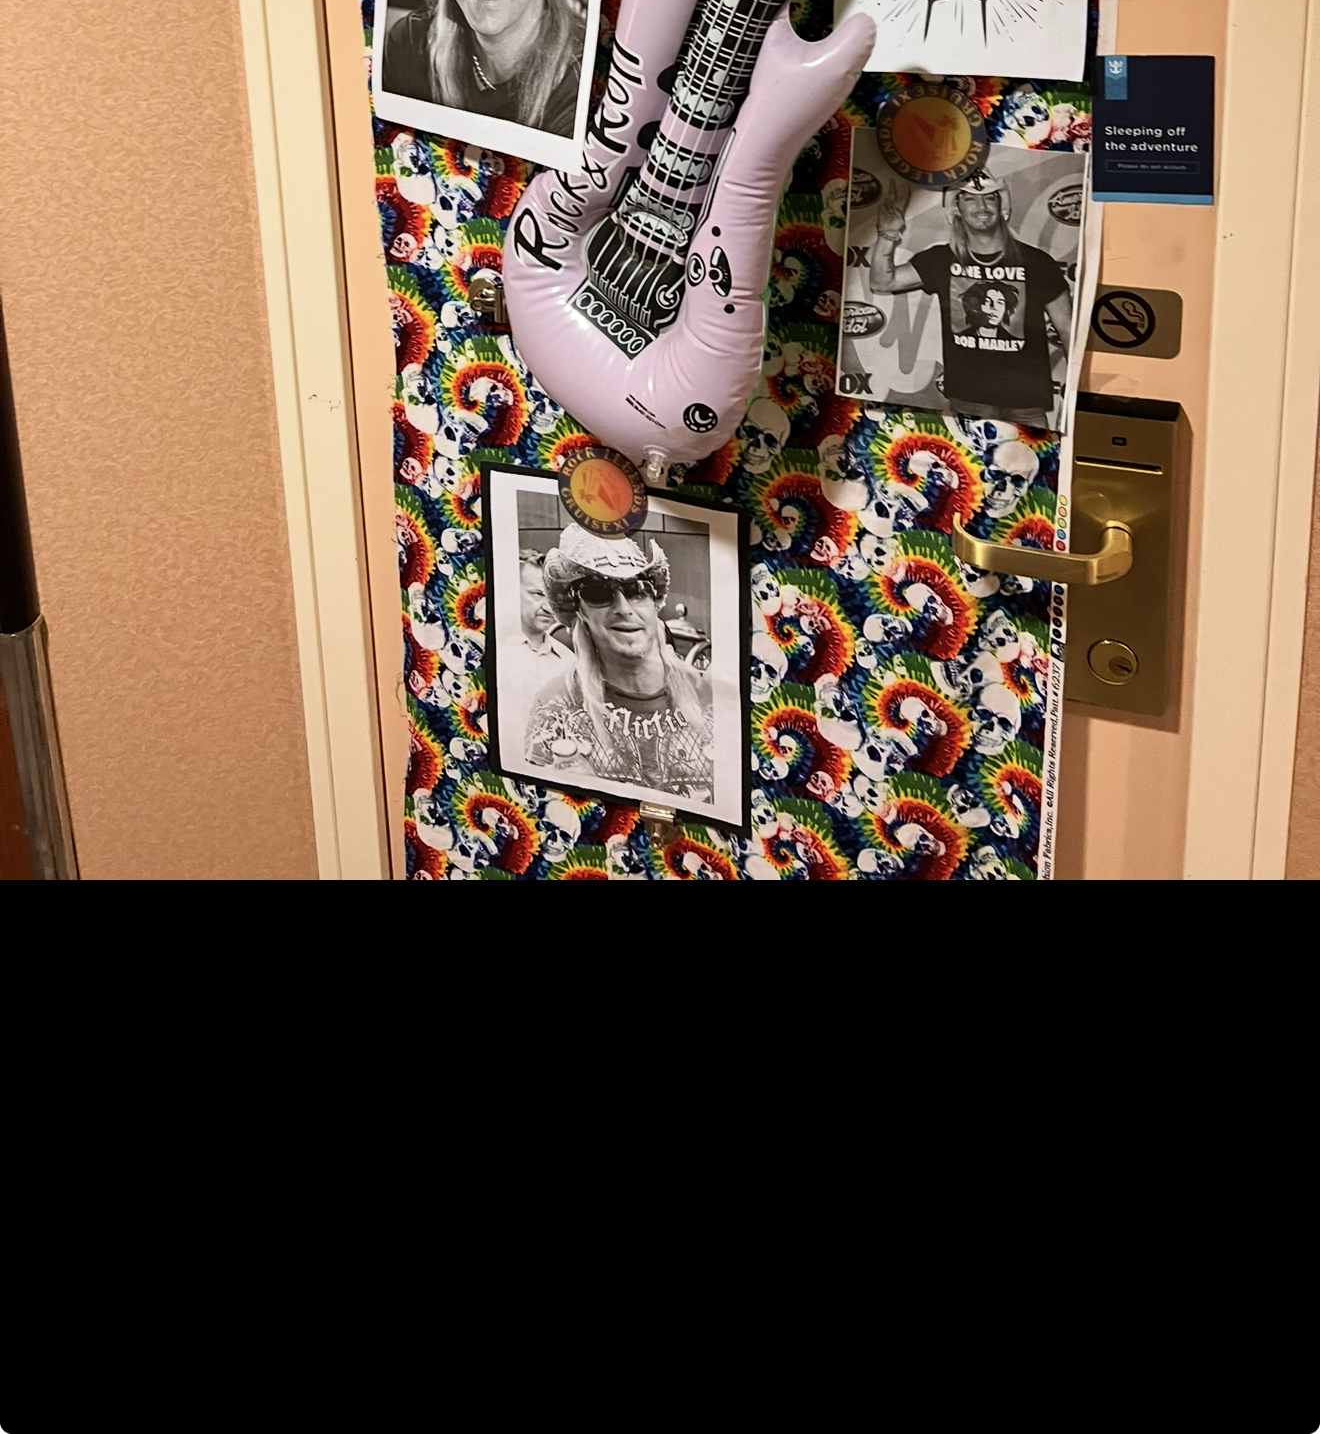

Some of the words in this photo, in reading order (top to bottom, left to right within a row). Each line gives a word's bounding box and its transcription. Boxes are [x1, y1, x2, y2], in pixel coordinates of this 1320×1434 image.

[1104, 126, 1163, 138] Sleeping
[1167, 126, 1186, 136] off
[880, 117, 934, 184] LEGENDS
[942, 141, 984, 180] ROCK
[1105, 141, 1127, 151] the
[1130, 142, 1199, 153] adventure
[950, 262, 982, 279] ONE
[984, 266, 1026, 281] LOVE
[953, 334, 977, 348] BOB
[978, 337, 1026, 352] MARLEY
[562, 446, 597, 477] ROCK
[561, 487, 611, 532] CRUISE
[1051, 662, 1062, 690] 6237
